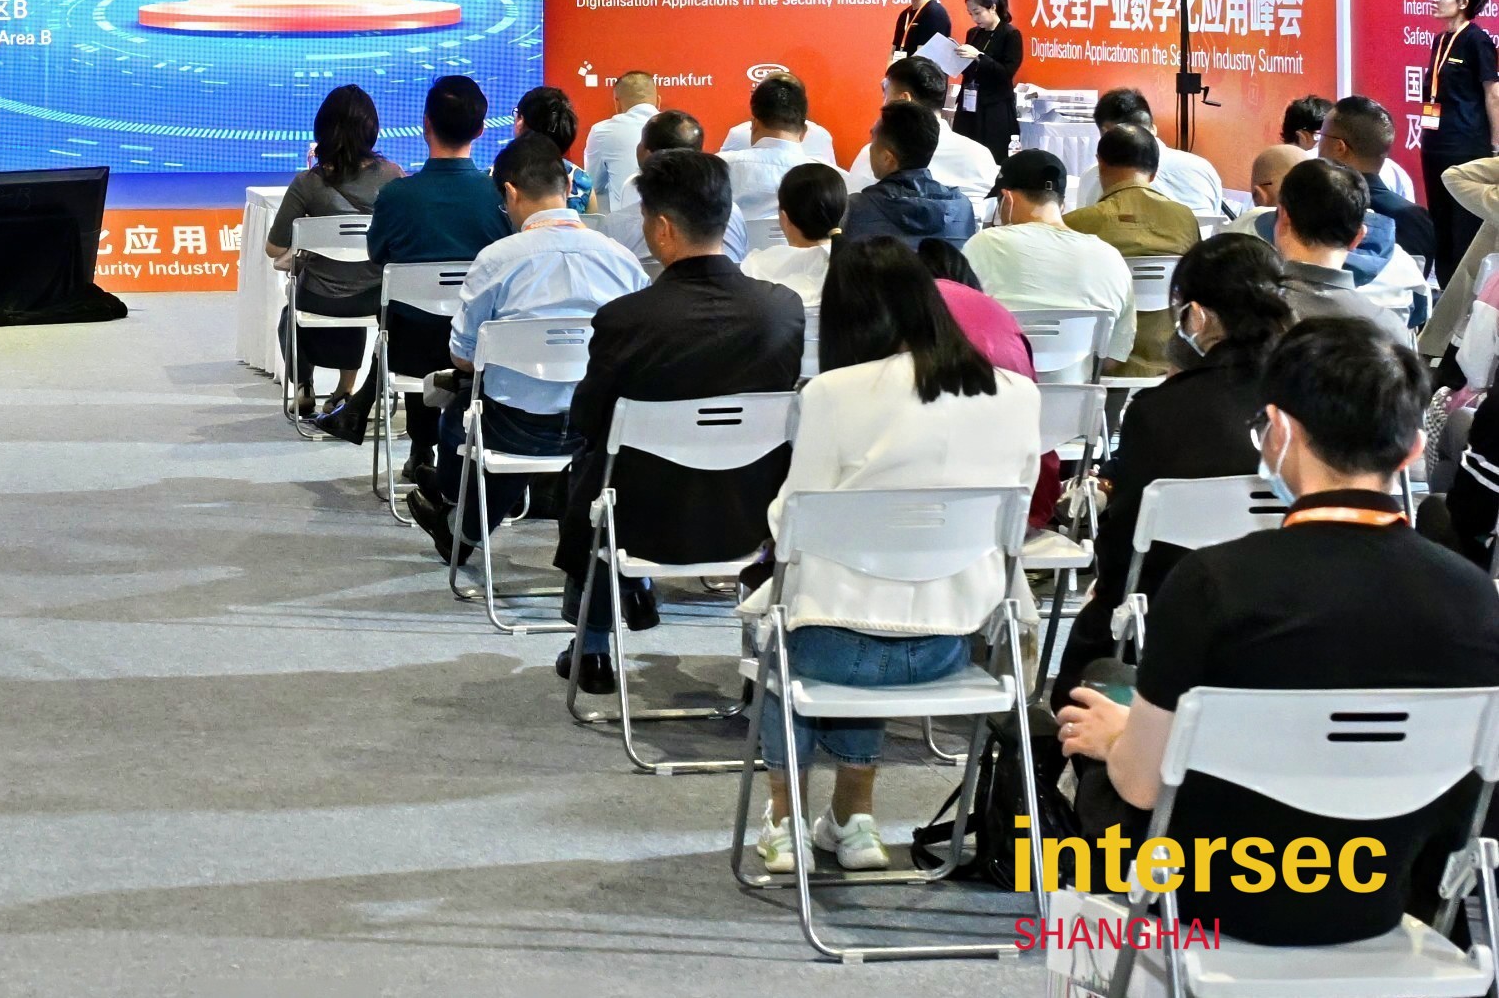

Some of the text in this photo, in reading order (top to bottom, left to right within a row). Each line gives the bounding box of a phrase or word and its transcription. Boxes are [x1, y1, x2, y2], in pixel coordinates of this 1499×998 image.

[41, 30, 52, 44] B
[1403, 26, 1435, 50] Safety
[1031, 37, 1304, 77] Digitalisation Applications in the Seurity Industry Summit
[653, 73, 713, 86] frankfurt
[94, 261, 142, 279] urity
[149, 260, 230, 277] Industry
